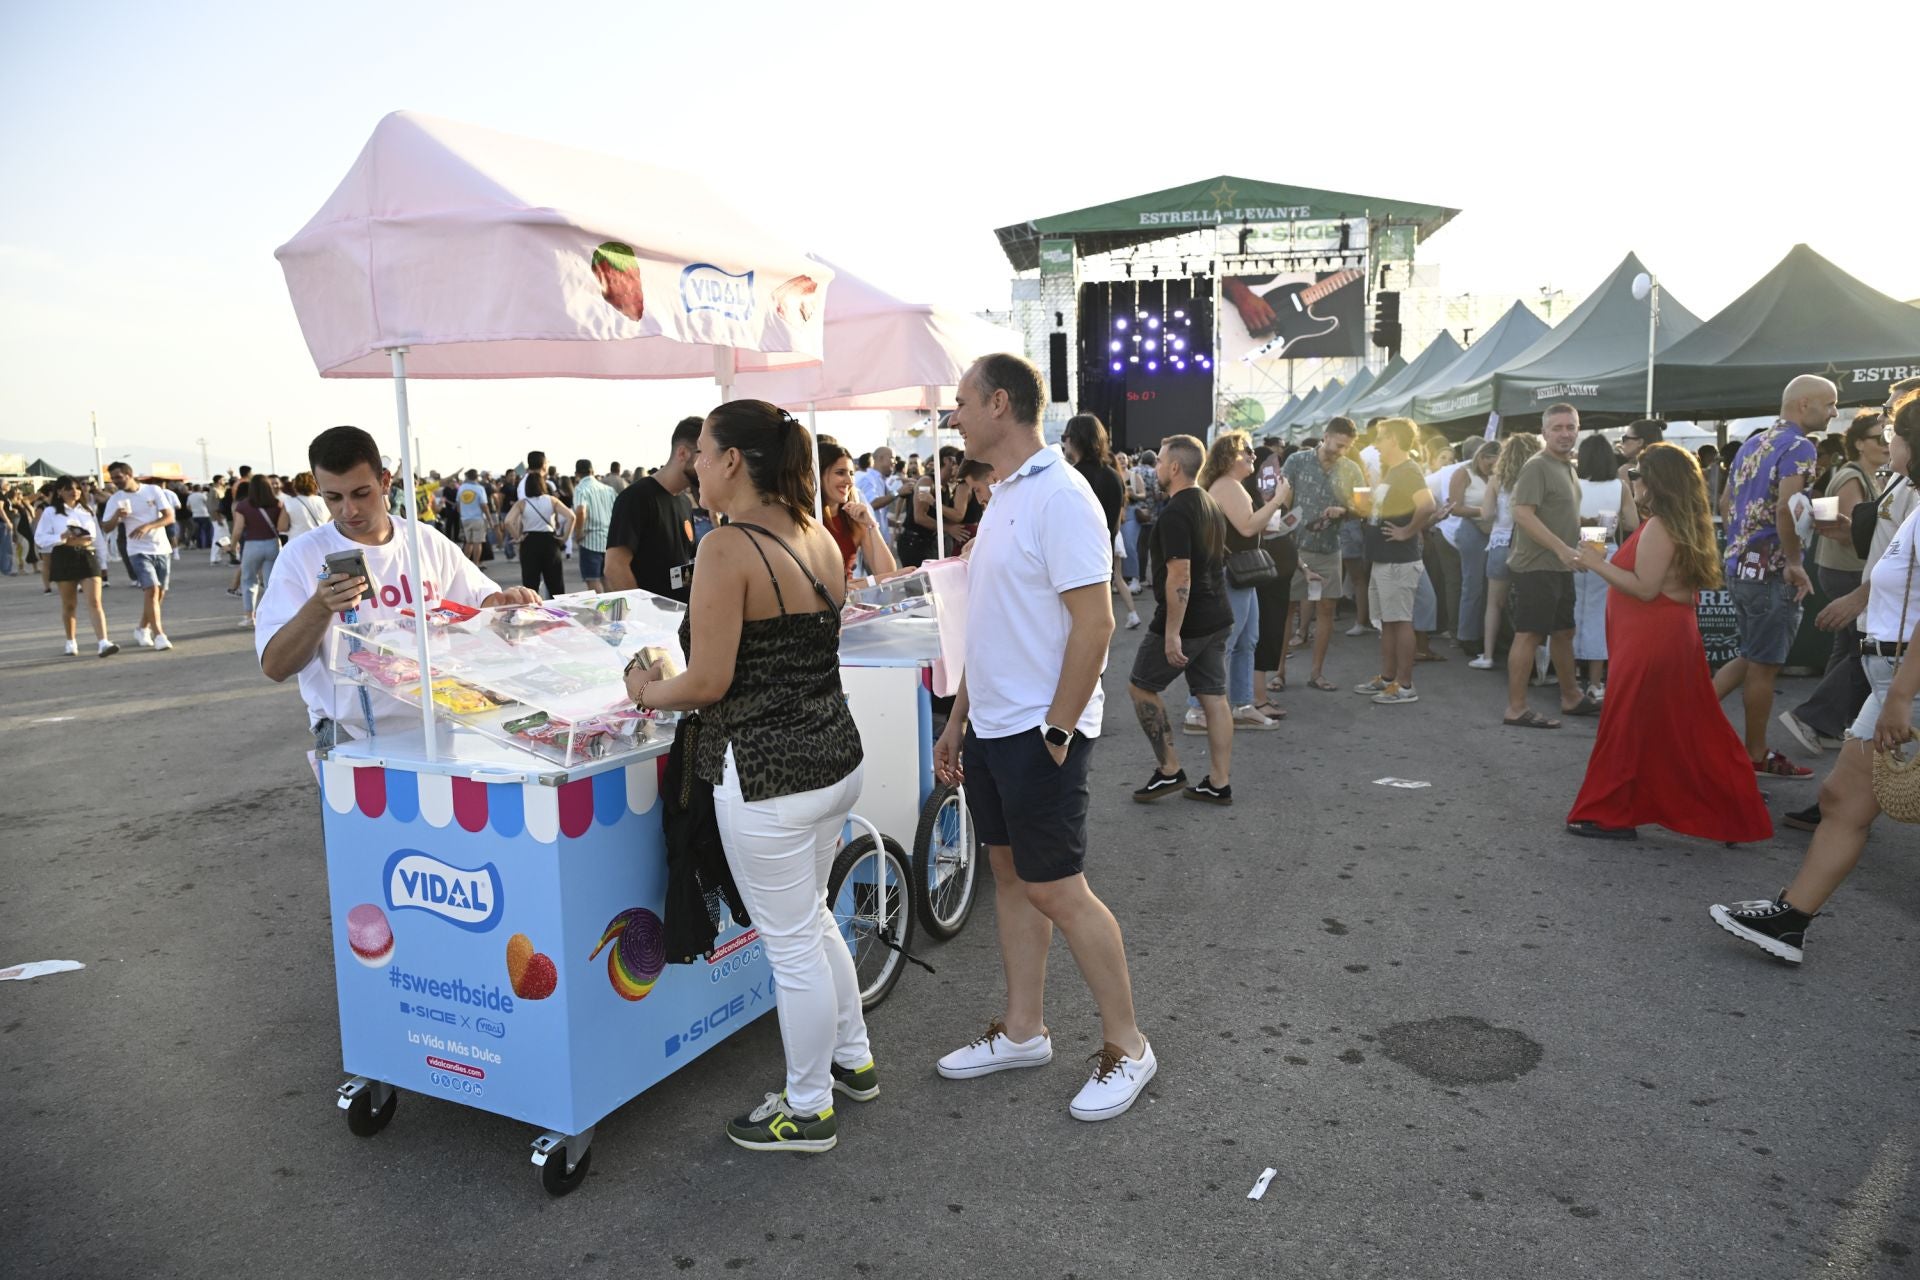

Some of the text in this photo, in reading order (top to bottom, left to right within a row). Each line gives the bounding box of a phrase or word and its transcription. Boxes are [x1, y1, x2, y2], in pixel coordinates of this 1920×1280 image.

[1139, 208, 1224, 225] ESTRELLA
[1235, 205, 1311, 220] LEVANTE
[691, 277, 747, 306] VIDAL
[1852, 365, 1920, 383] ESTRE
[1698, 606, 1737, 615] LEVAN
[399, 868, 488, 912] VIDAL
[389, 965, 514, 1014] #sweetbside
[480, 1021, 502, 1034] VIDAL
[408, 1030, 502, 1064] La Vida Más Dulce
[428, 1057, 482, 1077] vidalcandies.com
